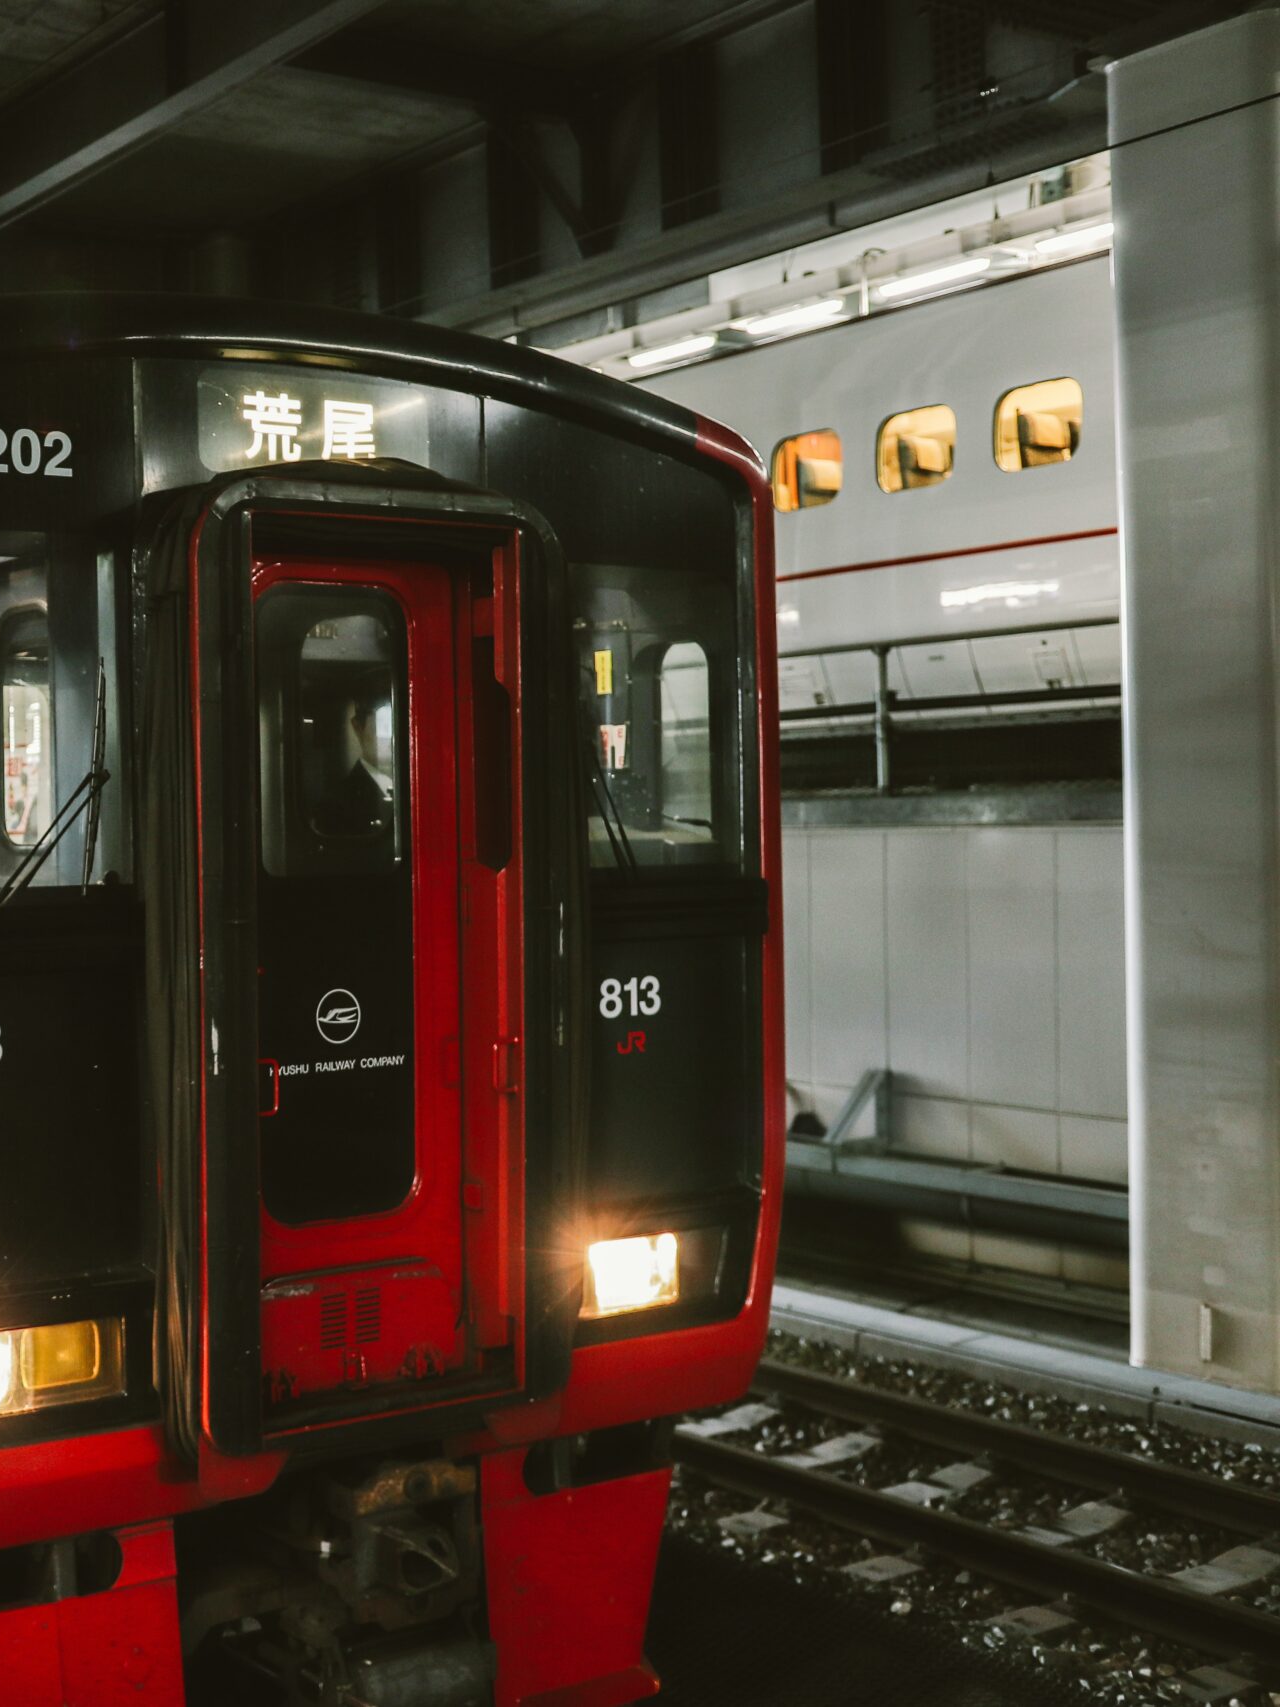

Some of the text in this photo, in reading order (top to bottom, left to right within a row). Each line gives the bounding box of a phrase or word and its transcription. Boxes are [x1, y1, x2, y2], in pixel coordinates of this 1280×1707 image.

[242, 391, 377, 462] 荒尾
[597, 975, 662, 1019] 813
[616, 1030, 646, 1055] JR
[315, 1059, 356, 1073] RAILWAY
[360, 1054, 405, 1069] COMPANY
